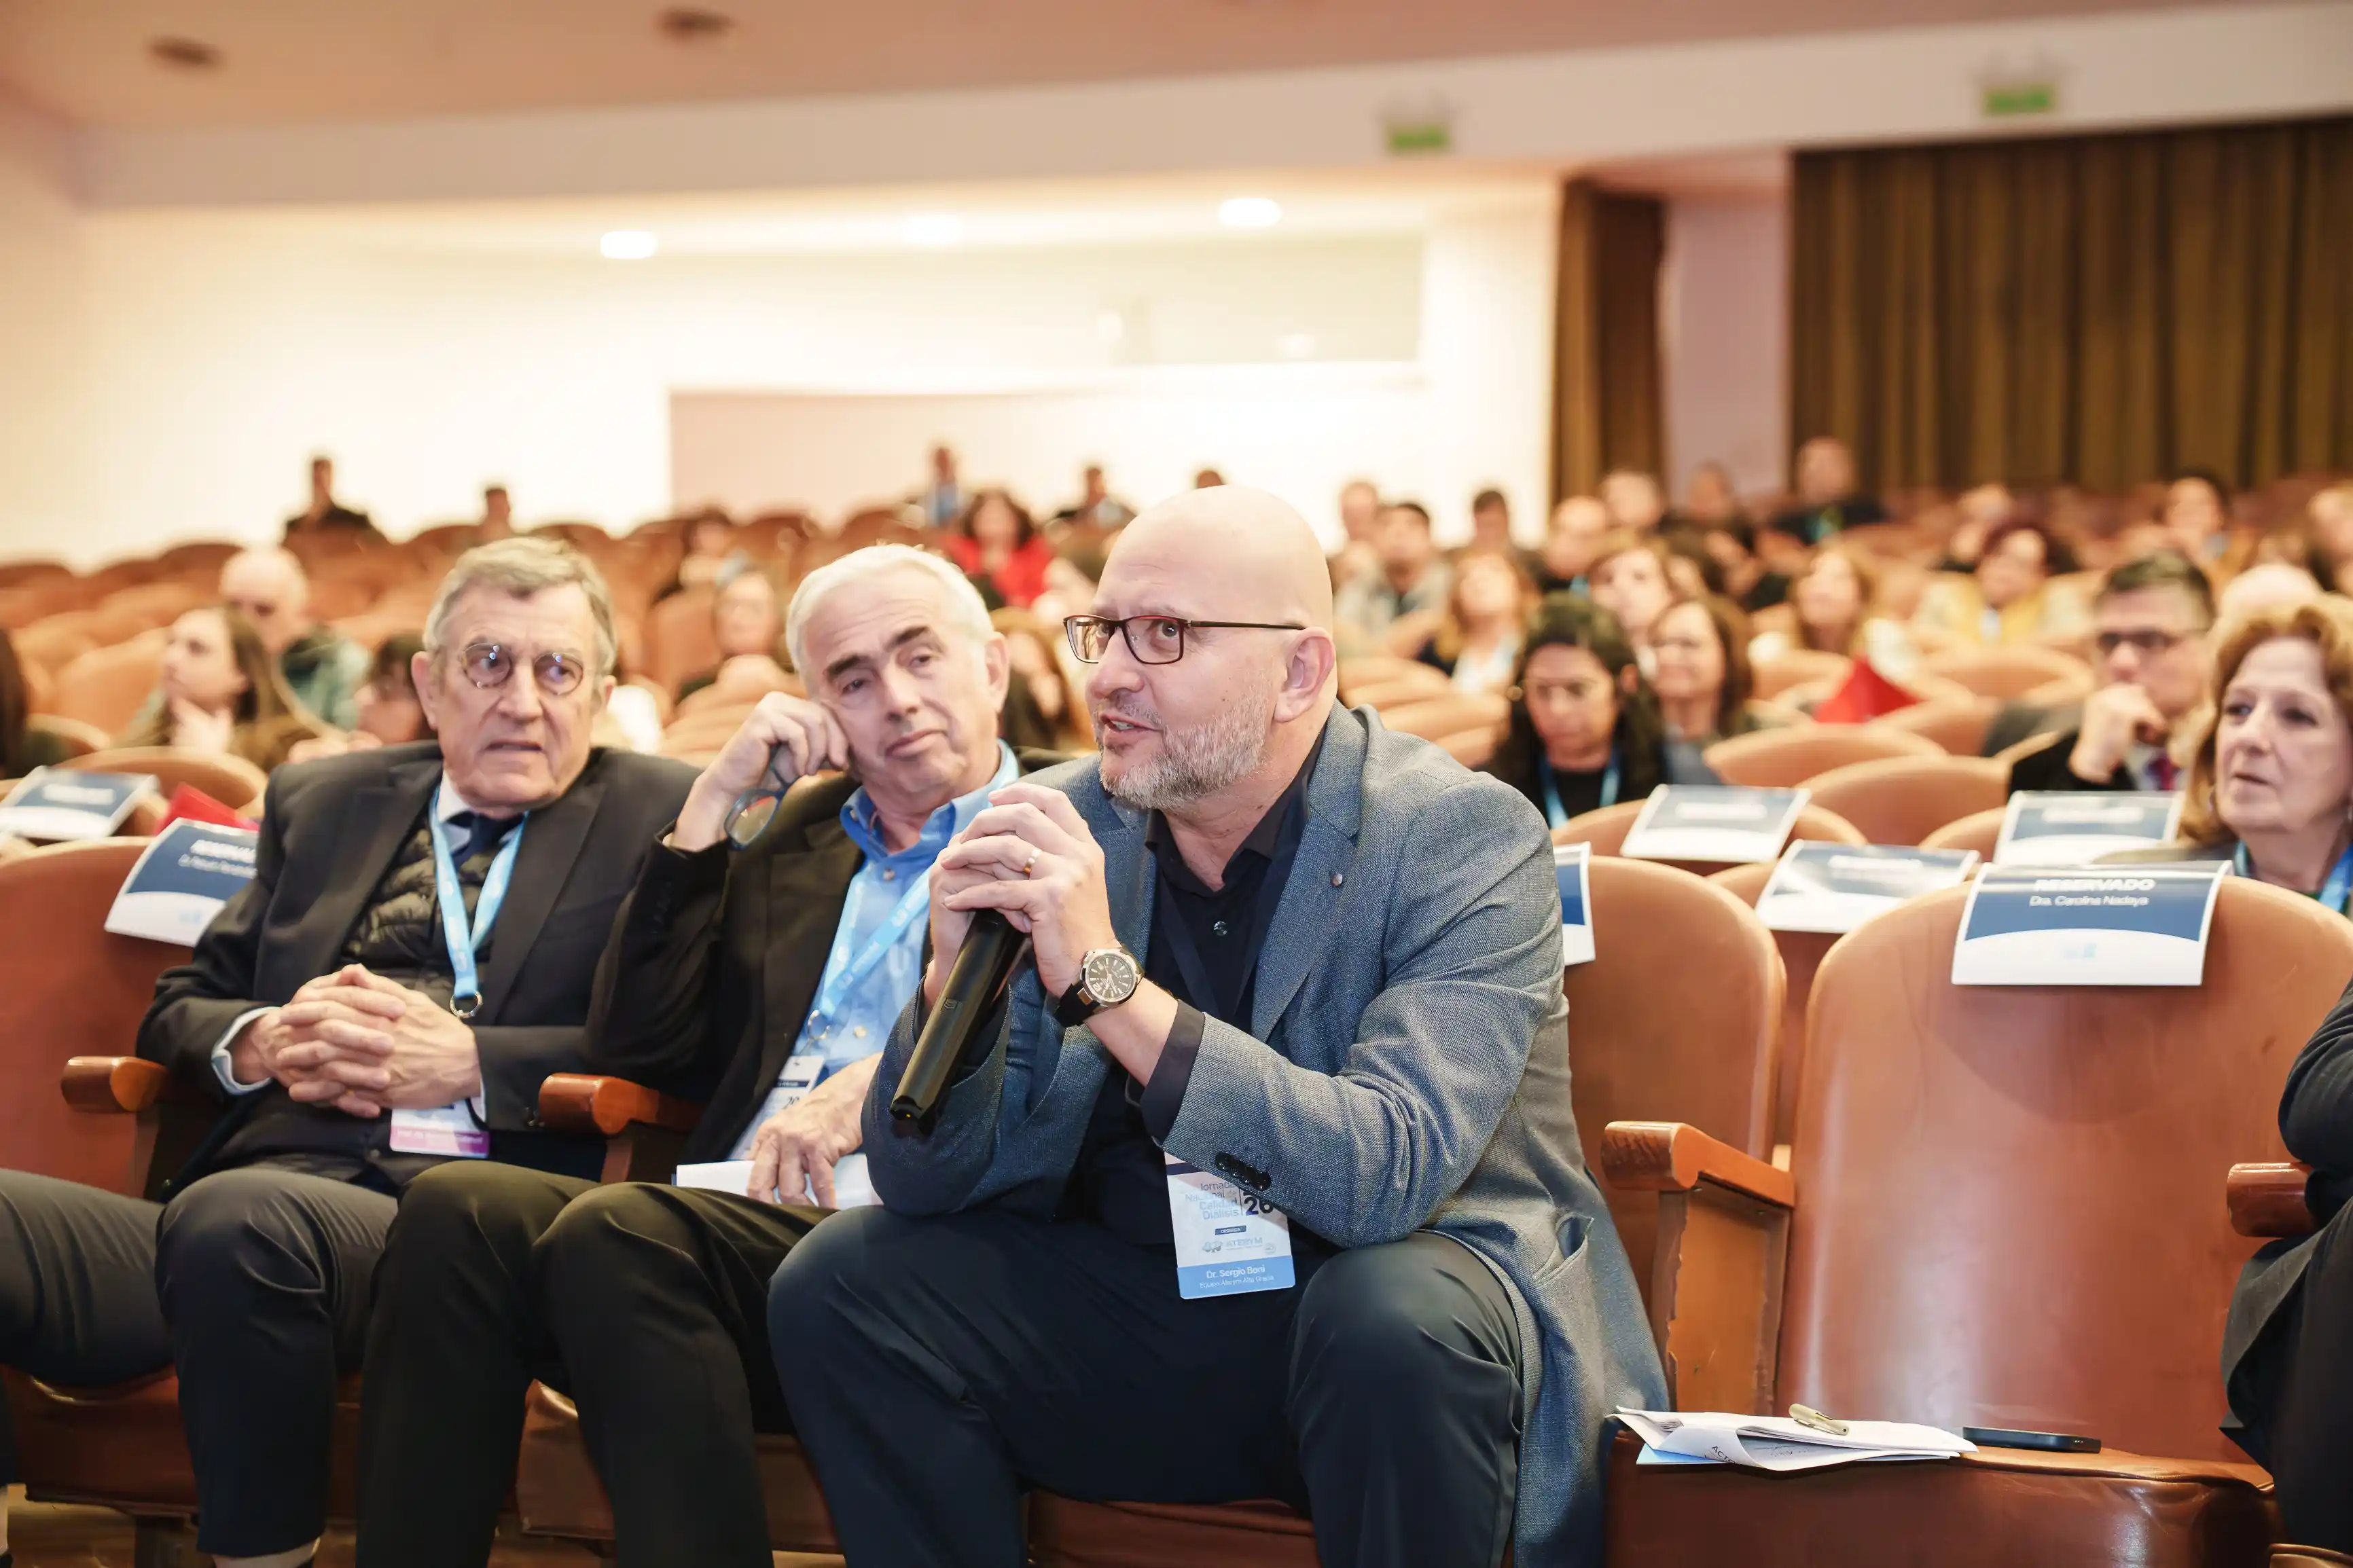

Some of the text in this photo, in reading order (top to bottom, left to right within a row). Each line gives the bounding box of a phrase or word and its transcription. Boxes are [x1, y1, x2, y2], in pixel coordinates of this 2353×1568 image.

[1206, 1264, 1265, 1279] Dr. Sergio Boni
